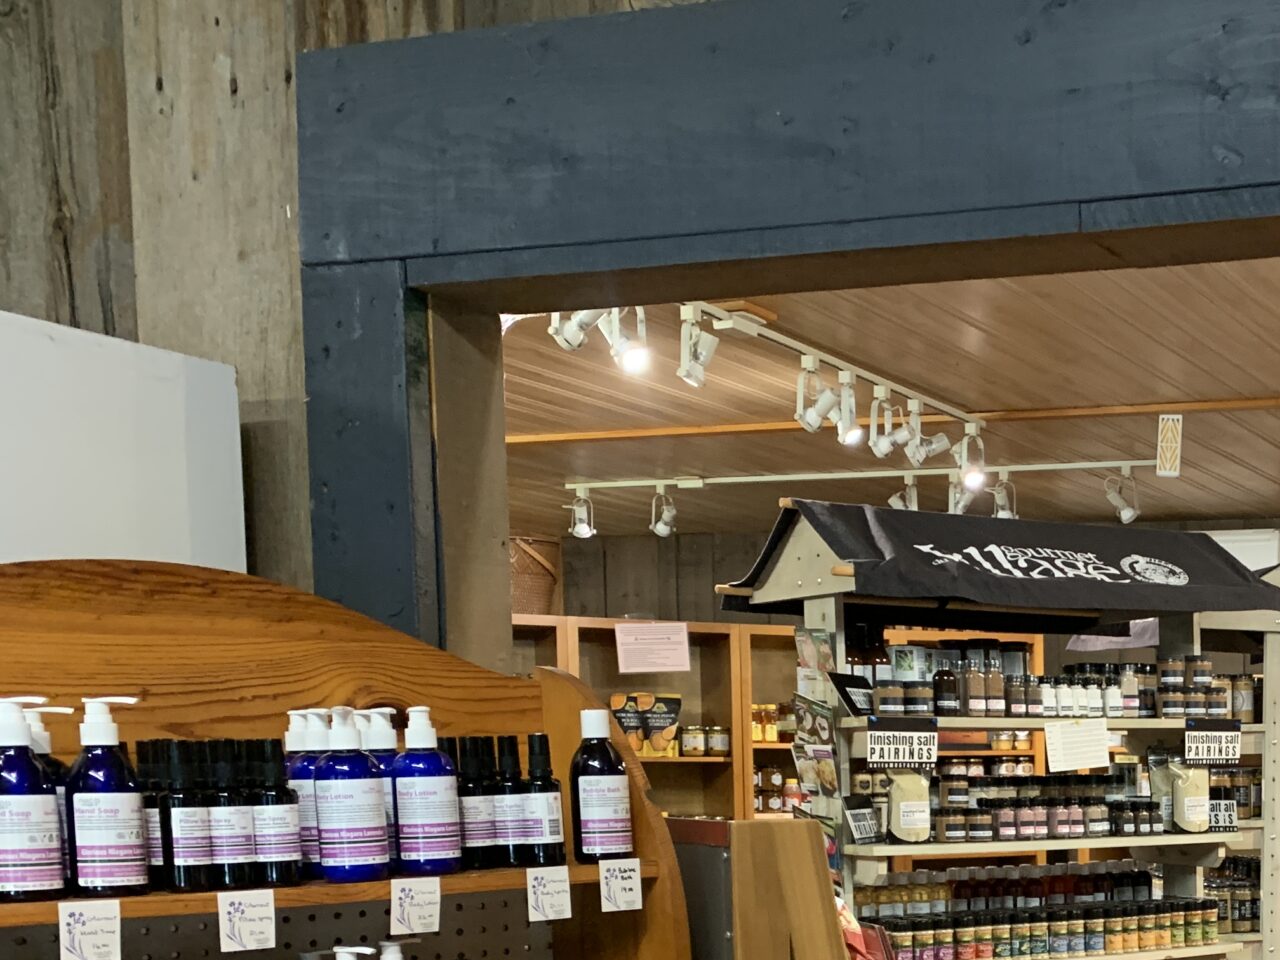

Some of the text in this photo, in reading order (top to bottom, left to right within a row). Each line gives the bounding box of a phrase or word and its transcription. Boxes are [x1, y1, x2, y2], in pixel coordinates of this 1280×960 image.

[869, 733, 936, 747] finishing salt
[1187, 733, 1240, 746] finishing salt
[869, 747, 933, 760] PAIRINGS
[1187, 746, 1237, 757] PAIRINGS
